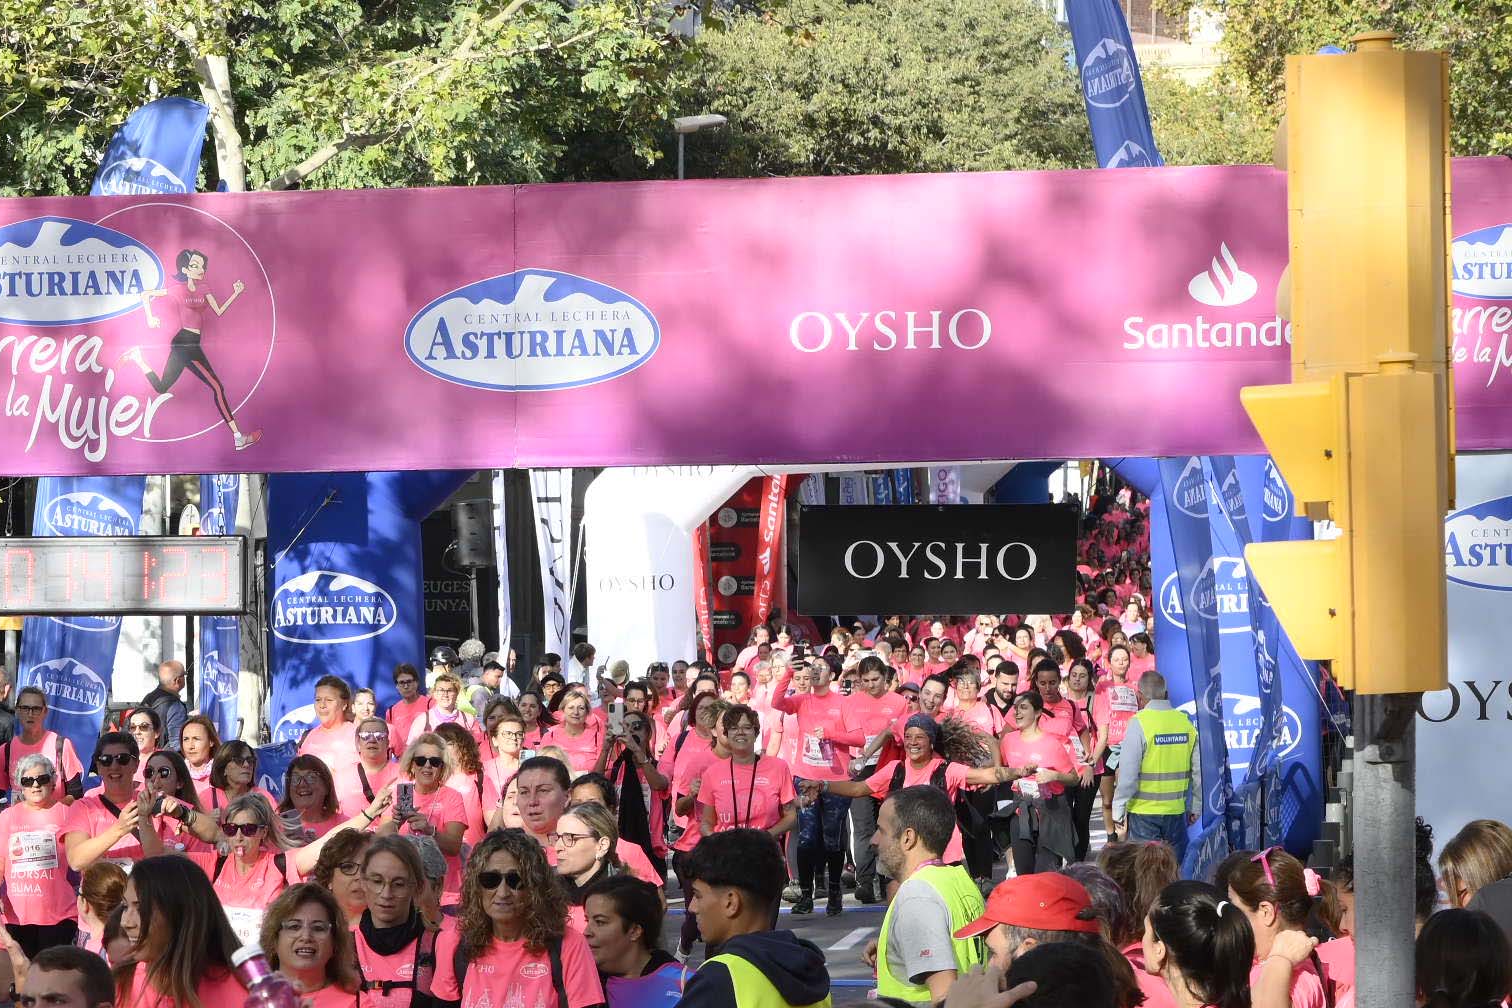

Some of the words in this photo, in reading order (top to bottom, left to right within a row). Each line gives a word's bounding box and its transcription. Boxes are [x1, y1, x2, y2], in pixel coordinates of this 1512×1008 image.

[67, 253, 138, 265] LECHERA
[464, 312, 542, 325] CENTRAL
[551, 309, 631, 323] LECHERA
[790, 308, 992, 353] OYSHO
[425, 316, 640, 360] ASTURIANA
[5, 378, 31, 417] la
[25, 369, 175, 463] Mujer
[844, 540, 1038, 581] OYSHO
[274, 599, 389, 628] ASTURIANA
[287, 596, 329, 605] CENTRAL
[334, 594, 384, 605] LECHERA
[33, 674, 101, 709] ASTURIANA
